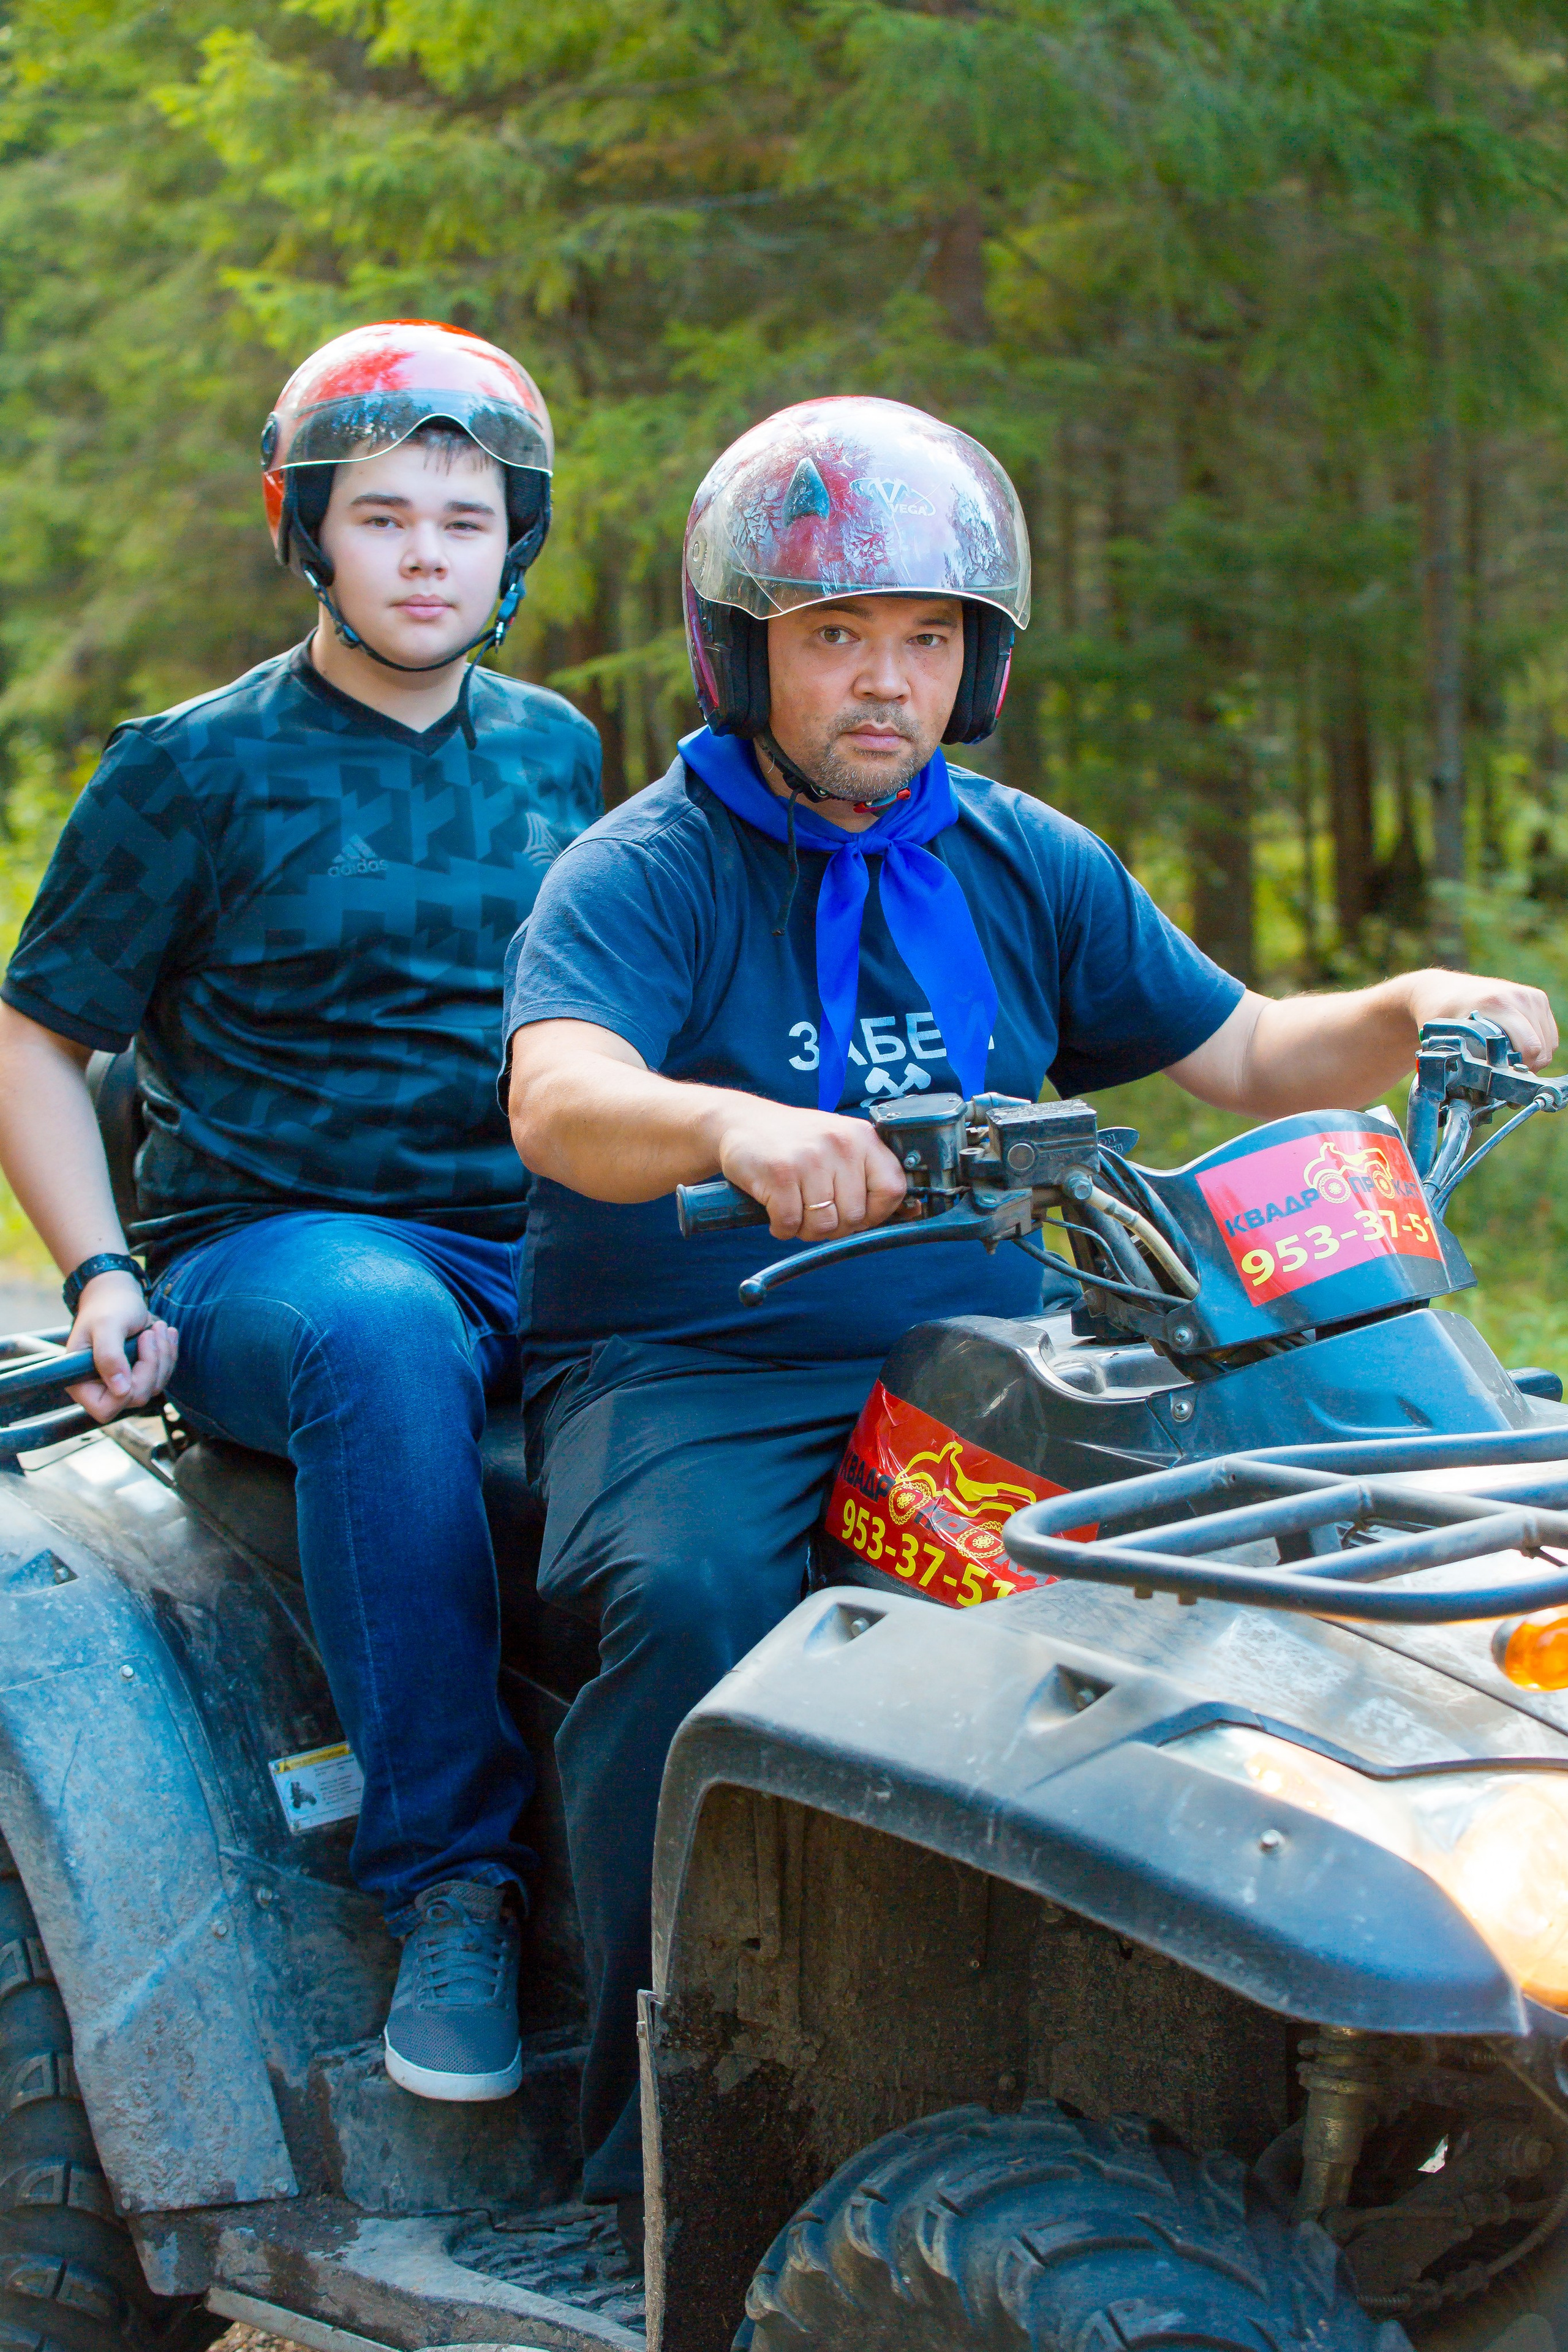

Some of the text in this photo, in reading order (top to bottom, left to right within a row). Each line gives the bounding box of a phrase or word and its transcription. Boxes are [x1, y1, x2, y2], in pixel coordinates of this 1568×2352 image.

[889, 503, 929, 516] VEGA
[328, 859, 388, 878] adidas
[788, 1012, 995, 1071] ЗБЕ
[1240, 1209, 1440, 1286] 953-37-51
